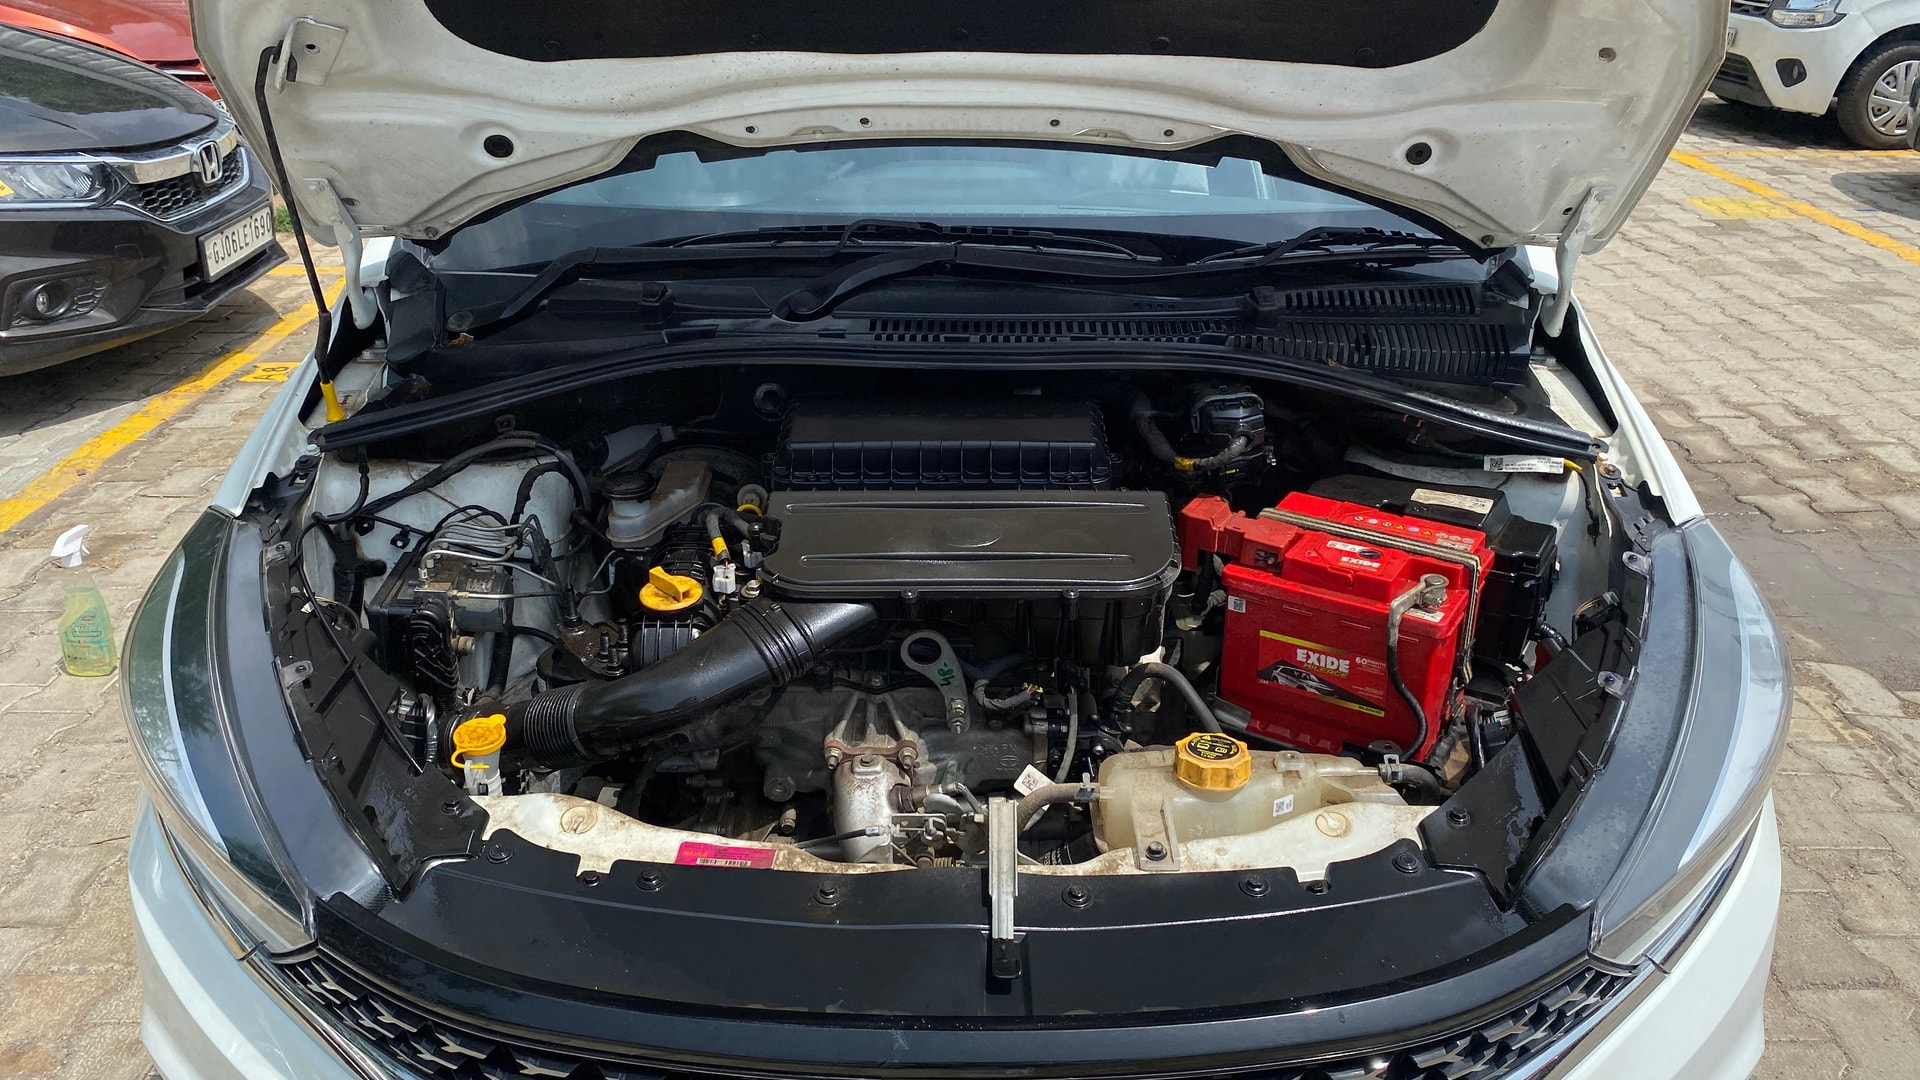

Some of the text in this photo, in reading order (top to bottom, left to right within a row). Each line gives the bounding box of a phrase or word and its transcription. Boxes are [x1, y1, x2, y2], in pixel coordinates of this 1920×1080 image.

[212, 211, 272, 264] GJ06LE1690
[1340, 556, 1381, 568] EXIDE
[1296, 648, 1350, 673] EXIDE
[1355, 656, 1367, 665] 60
